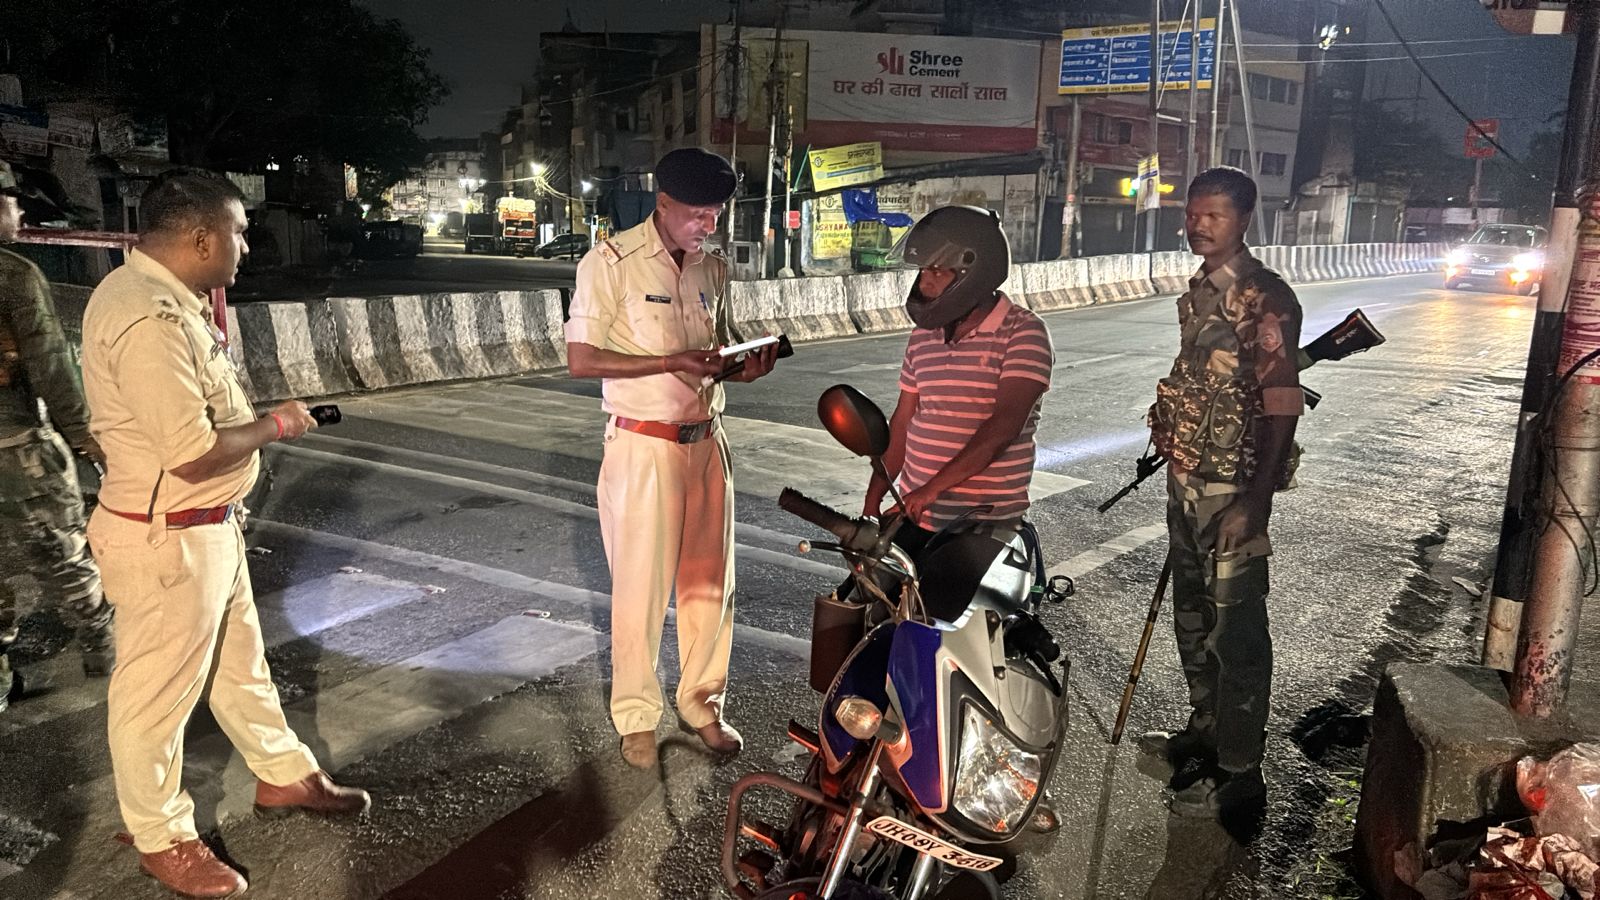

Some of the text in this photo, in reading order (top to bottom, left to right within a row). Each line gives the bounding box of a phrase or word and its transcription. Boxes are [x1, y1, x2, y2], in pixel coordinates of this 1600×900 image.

[909, 50, 963, 67] Shree
[909, 66, 961, 78] Cement
[833, 80, 856, 95] घर
[861, 78, 884, 96] की
[889, 82, 922, 98] ढाल
[974, 86, 1008, 101] साल
